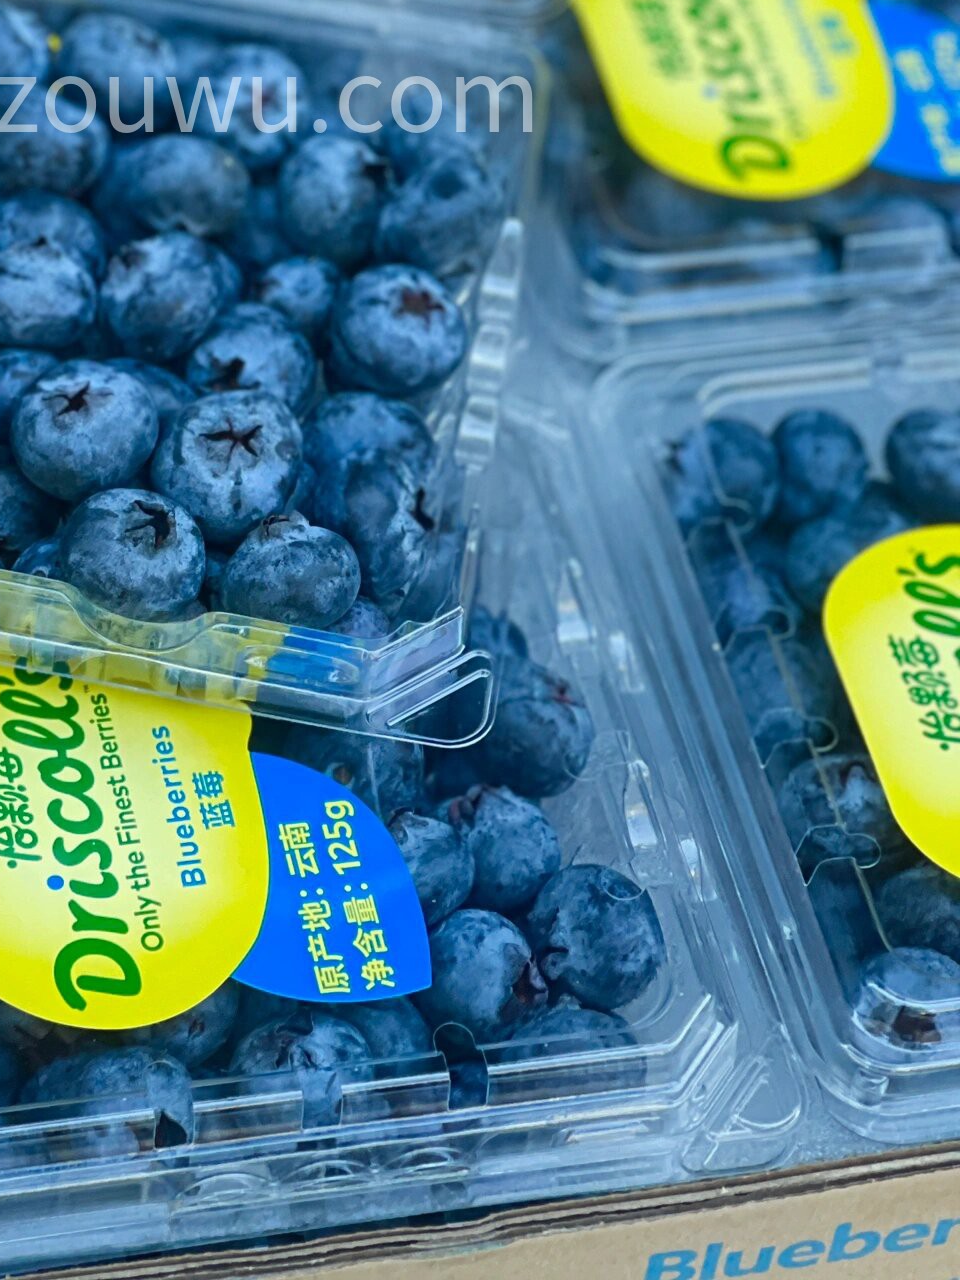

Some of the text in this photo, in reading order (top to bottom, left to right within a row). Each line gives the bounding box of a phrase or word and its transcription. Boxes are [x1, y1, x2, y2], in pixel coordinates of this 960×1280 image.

[107, 774, 141, 846] Finest
[152, 725, 207, 888] Blueberries
[192, 770, 236, 830] 蓝莓
[126, 851, 151, 892] the
[133, 896, 164, 951] Only
